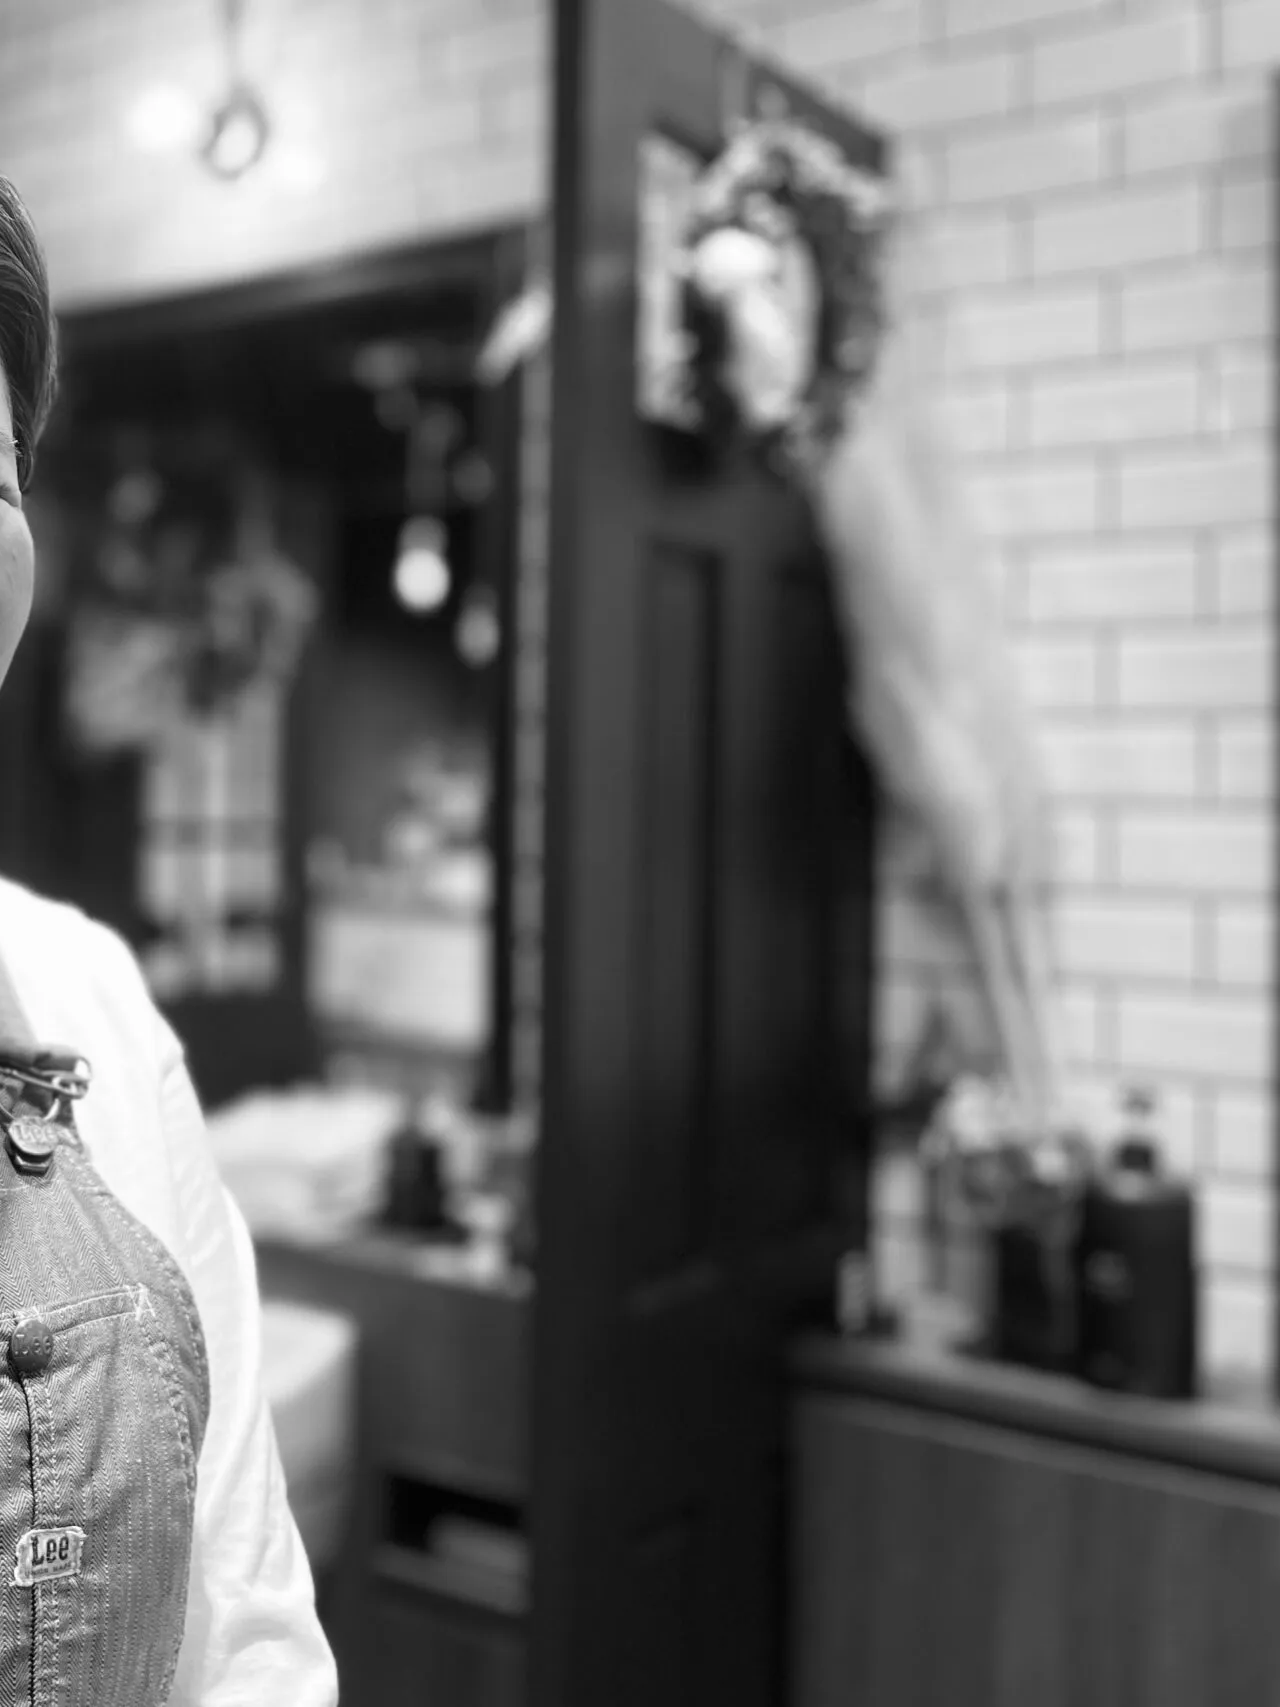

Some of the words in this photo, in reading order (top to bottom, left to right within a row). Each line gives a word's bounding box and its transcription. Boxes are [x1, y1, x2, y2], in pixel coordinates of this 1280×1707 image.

[14, 1124, 55, 1144] Lee
[13, 1332, 51, 1357] Lee
[31, 1536, 69, 1567] Lee
